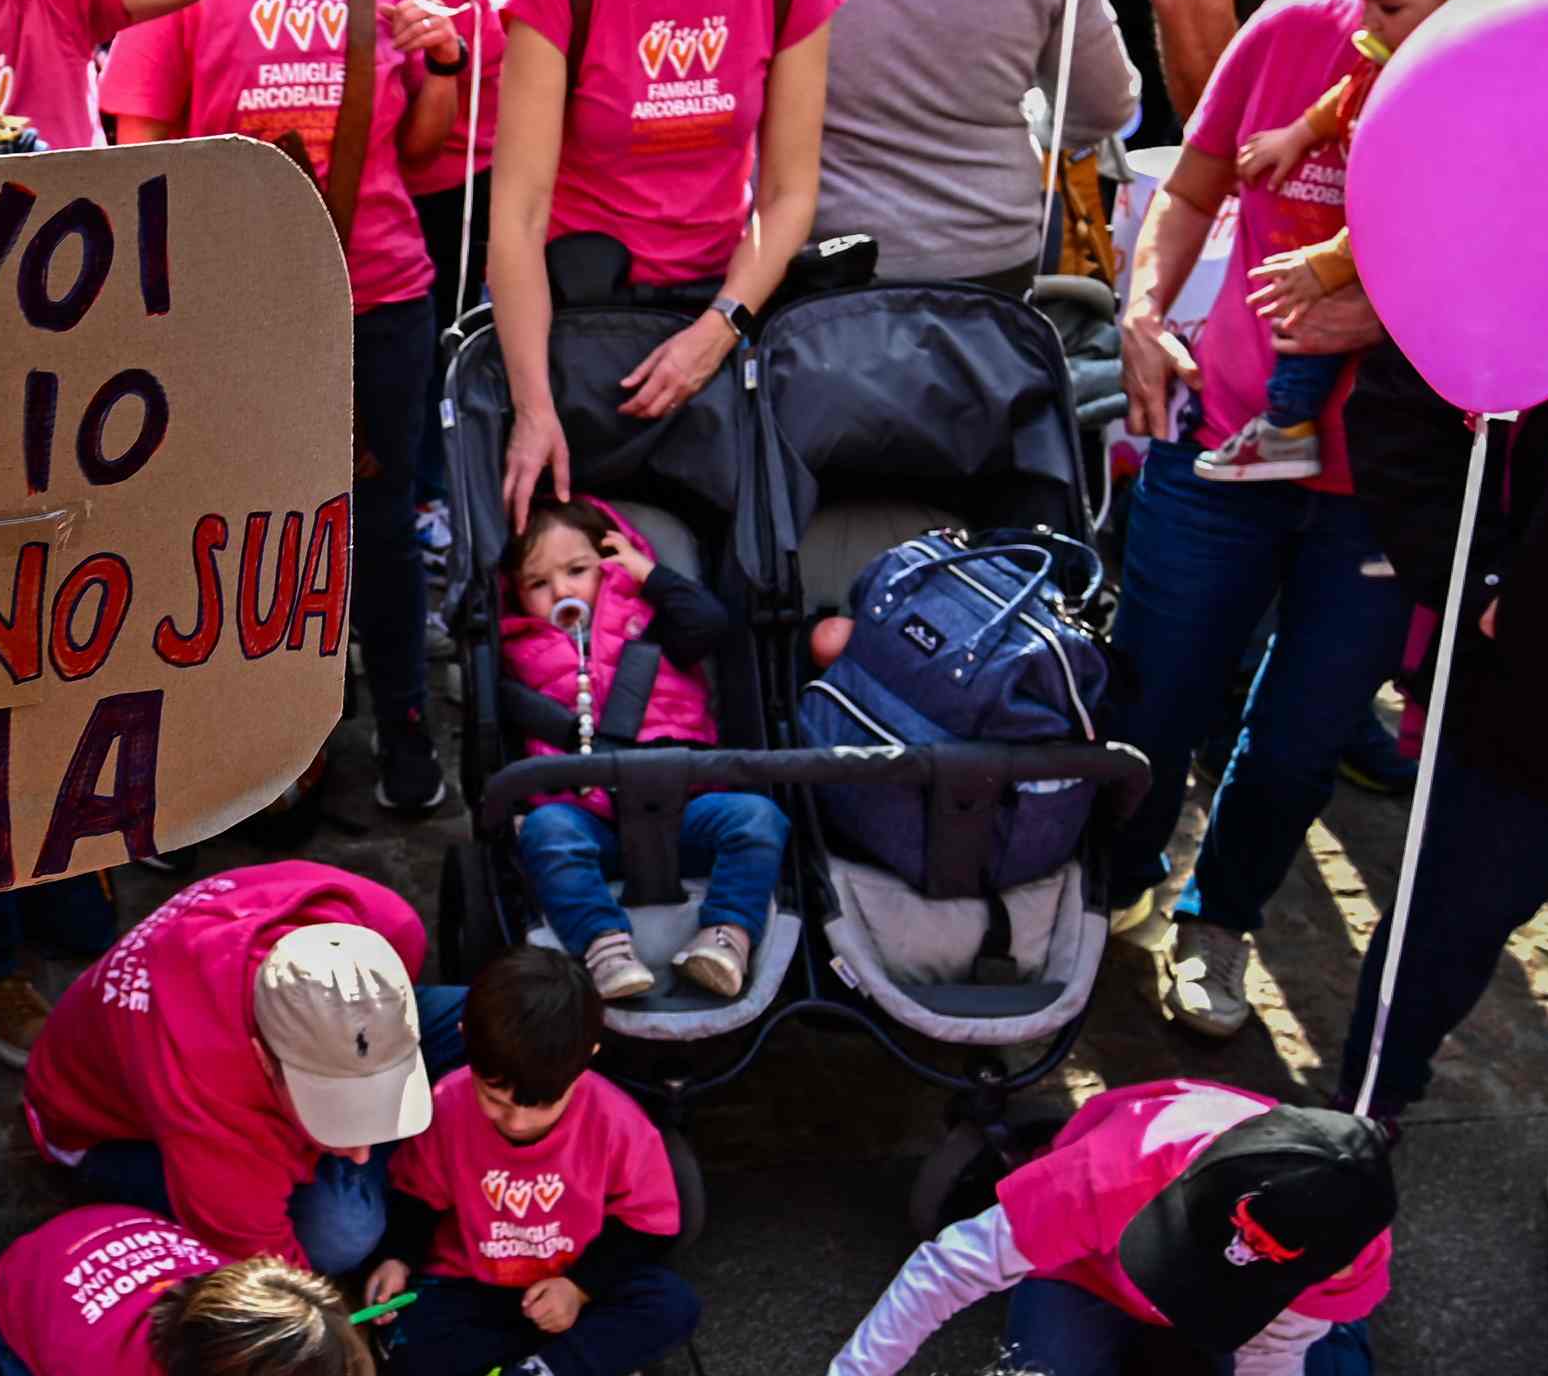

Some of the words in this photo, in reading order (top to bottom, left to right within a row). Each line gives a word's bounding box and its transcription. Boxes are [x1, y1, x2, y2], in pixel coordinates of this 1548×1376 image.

[647, 78, 721, 102] FAMIGLIE
[631, 92, 737, 120] ARCOBALENO
[155, 491, 352, 670] SUA
